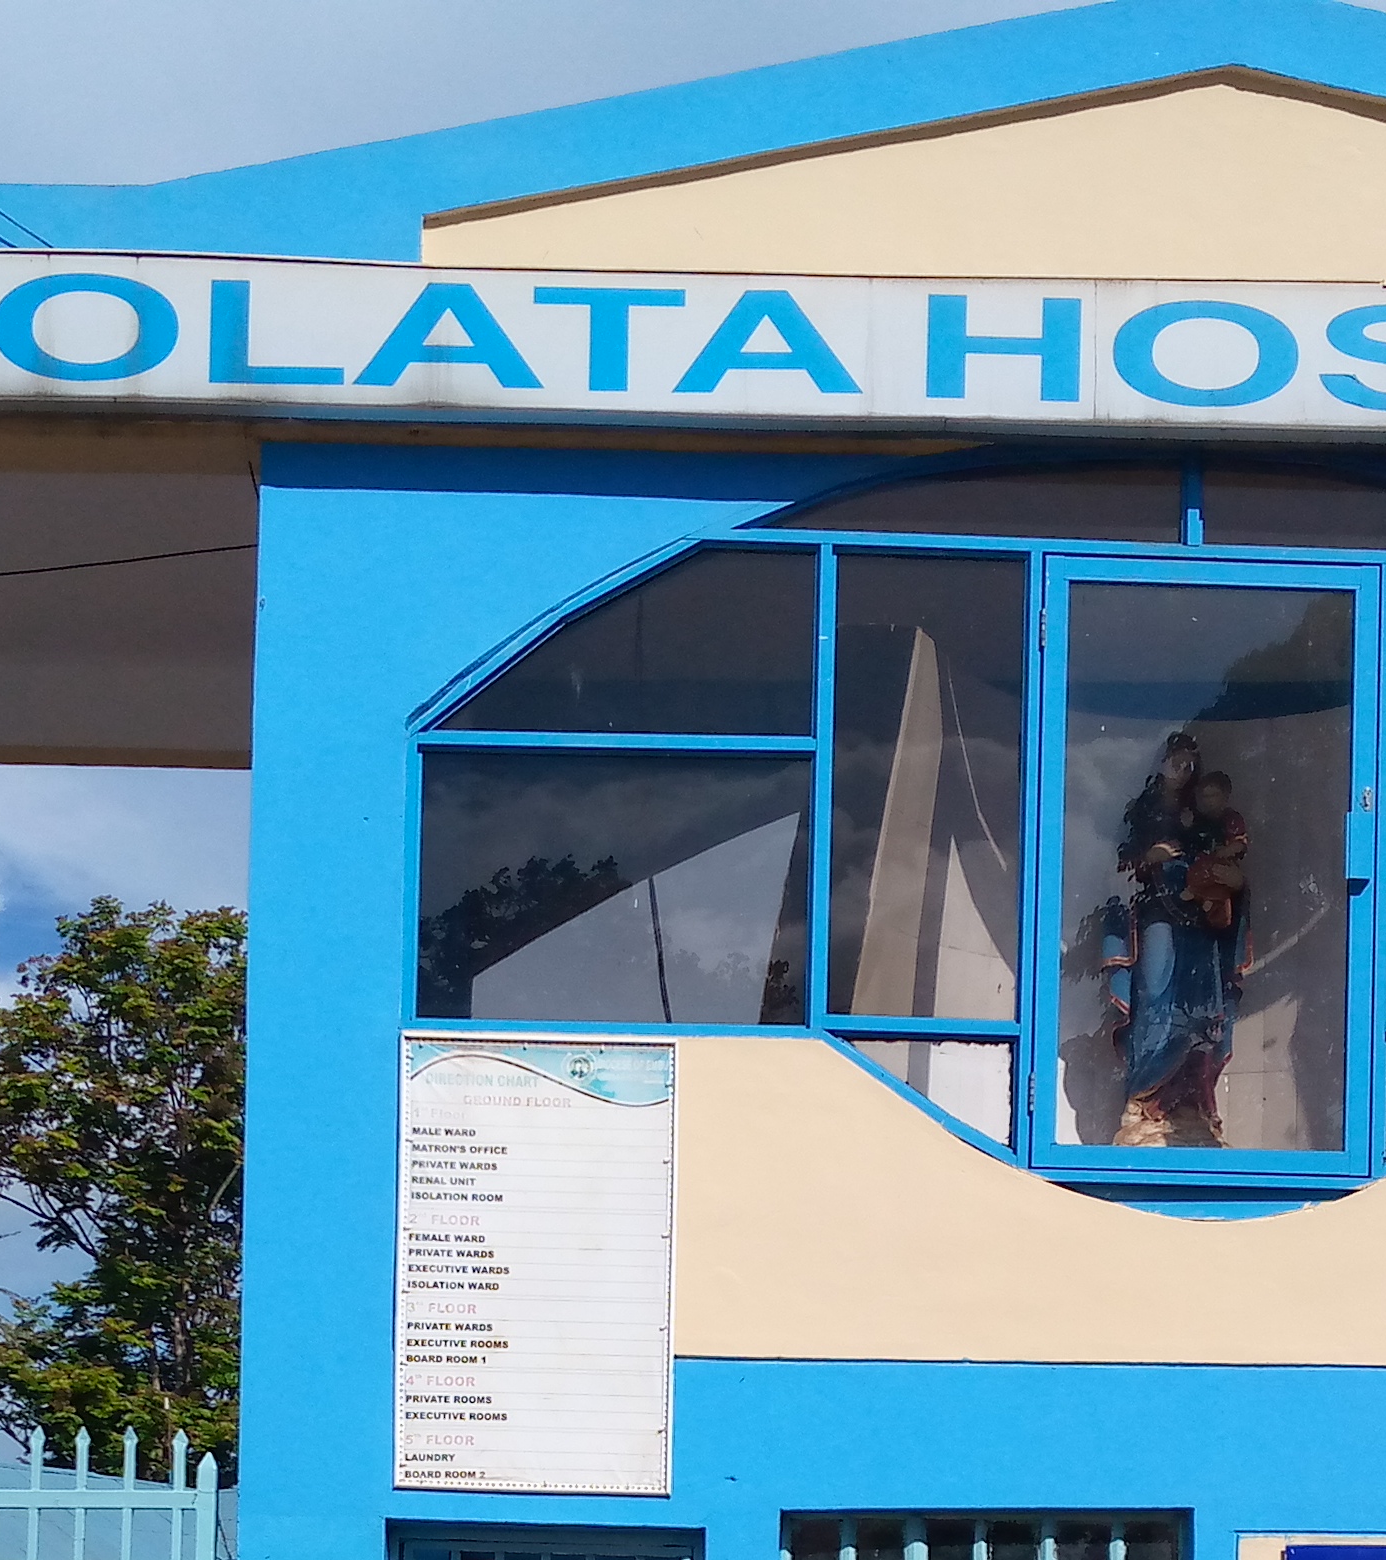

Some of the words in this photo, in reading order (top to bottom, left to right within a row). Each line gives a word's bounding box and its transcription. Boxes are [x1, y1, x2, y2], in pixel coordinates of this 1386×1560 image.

[497, 1076, 538, 1088] CHART
[463, 1096, 521, 1106] GROUND
[526, 1097, 571, 1107] FLOOR
[412, 1128, 441, 1136] MALE
[444, 1129, 476, 1137] WARD
[412, 1145, 466, 1154] MATRON'S
[470, 1145, 508, 1155] OFFICE
[412, 1161, 456, 1170] PRIVATE
[459, 1162, 497, 1171] WARDS
[412, 1176, 447, 1185] RENAL
[450, 1177, 476, 1186] UNIT
[412, 1192, 468, 1201] ISOLATION
[472, 1193, 503, 1202] ROOM
[431, 1215, 480, 1226] FLOOR
[409, 1234, 451, 1242] FEMALE
[454, 1235, 485, 1243] WARD
[409, 1249, 453, 1257] PRIVATE
[456, 1250, 494, 1258] WARDS
[409, 1265, 468, 1273] EXECUTIVE
[472, 1266, 510, 1274] WARDS
[408, 1281, 464, 1289] ISOLATION
[467, 1282, 499, 1290] WARD
[429, 1303, 476, 1314] FLOOR
[407, 1322, 452, 1331] PRIVATE
[455, 1323, 493, 1332] WARDS
[407, 1339, 467, 1348] EXECUTIVE
[470, 1340, 509, 1349] ROOMS
[407, 1355, 443, 1363] BOARD
[446, 1356, 478, 1364] ROOM
[427, 1375, 476, 1387] FLOOR
[406, 1395, 450, 1403] PRIVATE
[454, 1395, 492, 1404] ROOMS
[406, 1412, 466, 1420] EXECUTIVE
[469, 1412, 507, 1421] ROOMS
[426, 1435, 475, 1446] FLOOR
[405, 1453, 455, 1461] LAUNDRY
[445, 1471, 477, 1479] ROOM
